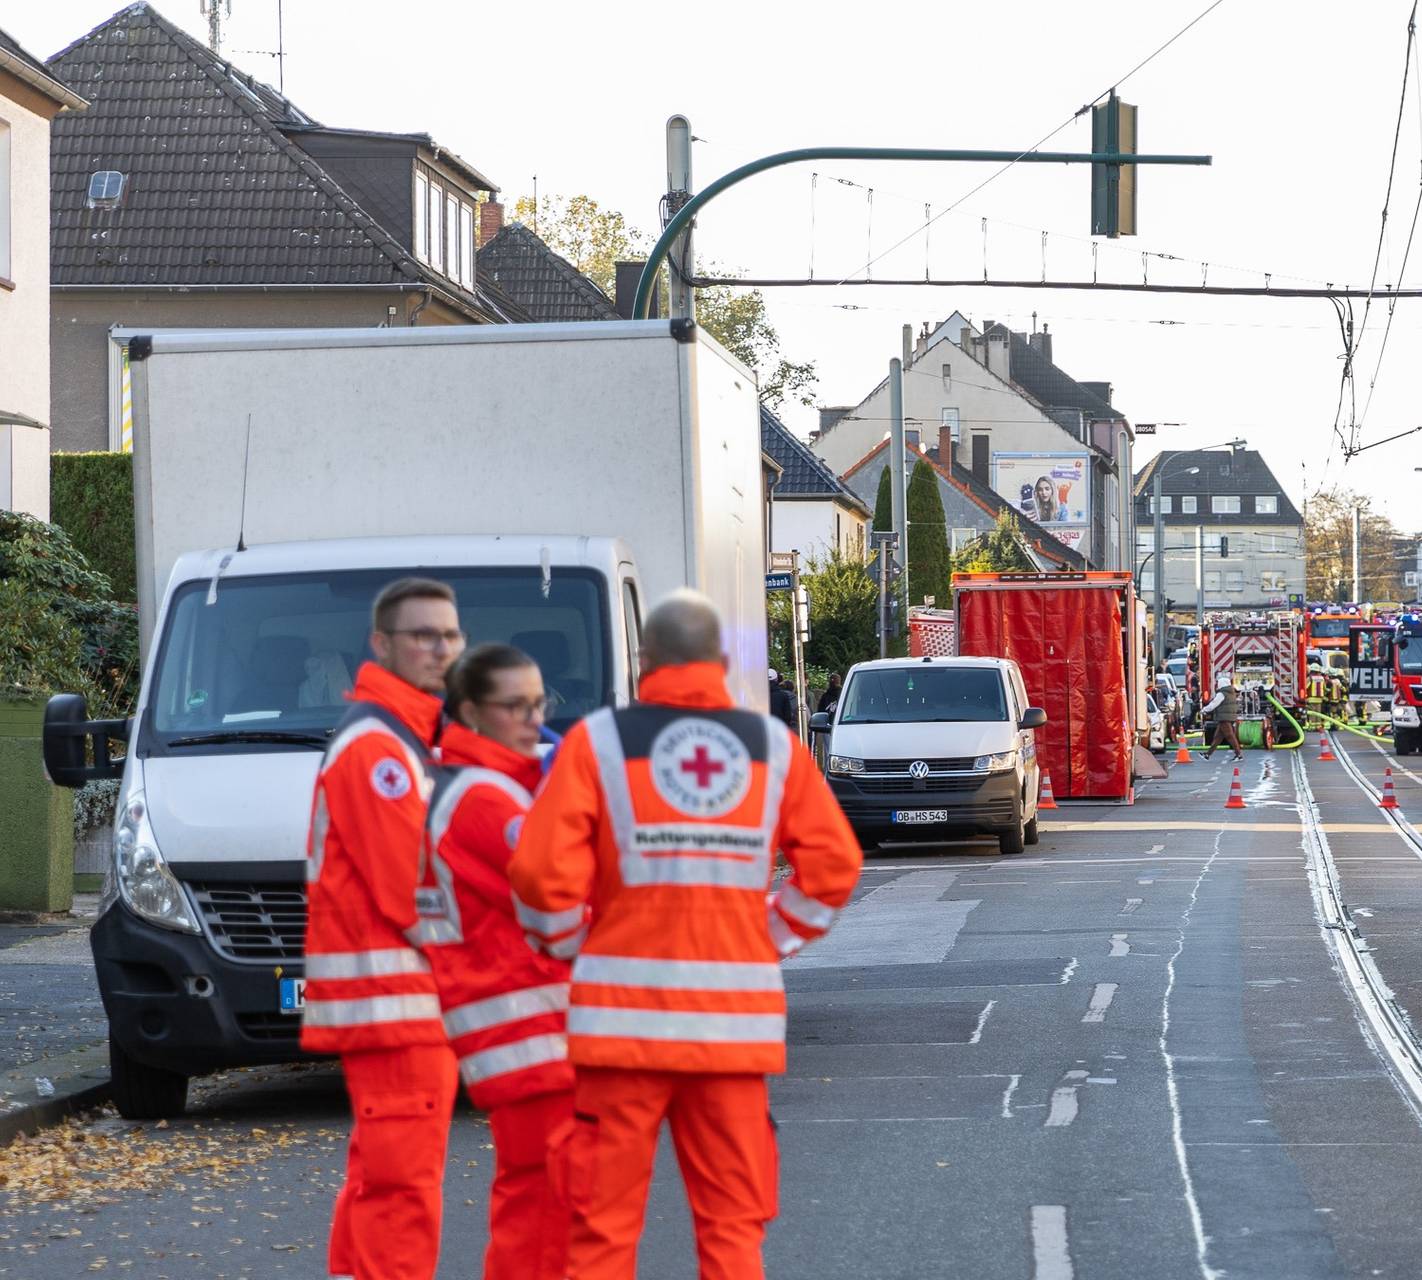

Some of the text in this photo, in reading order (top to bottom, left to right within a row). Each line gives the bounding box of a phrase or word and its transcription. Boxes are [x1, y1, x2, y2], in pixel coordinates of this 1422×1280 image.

[897, 811, 947, 821] OB HS 543
